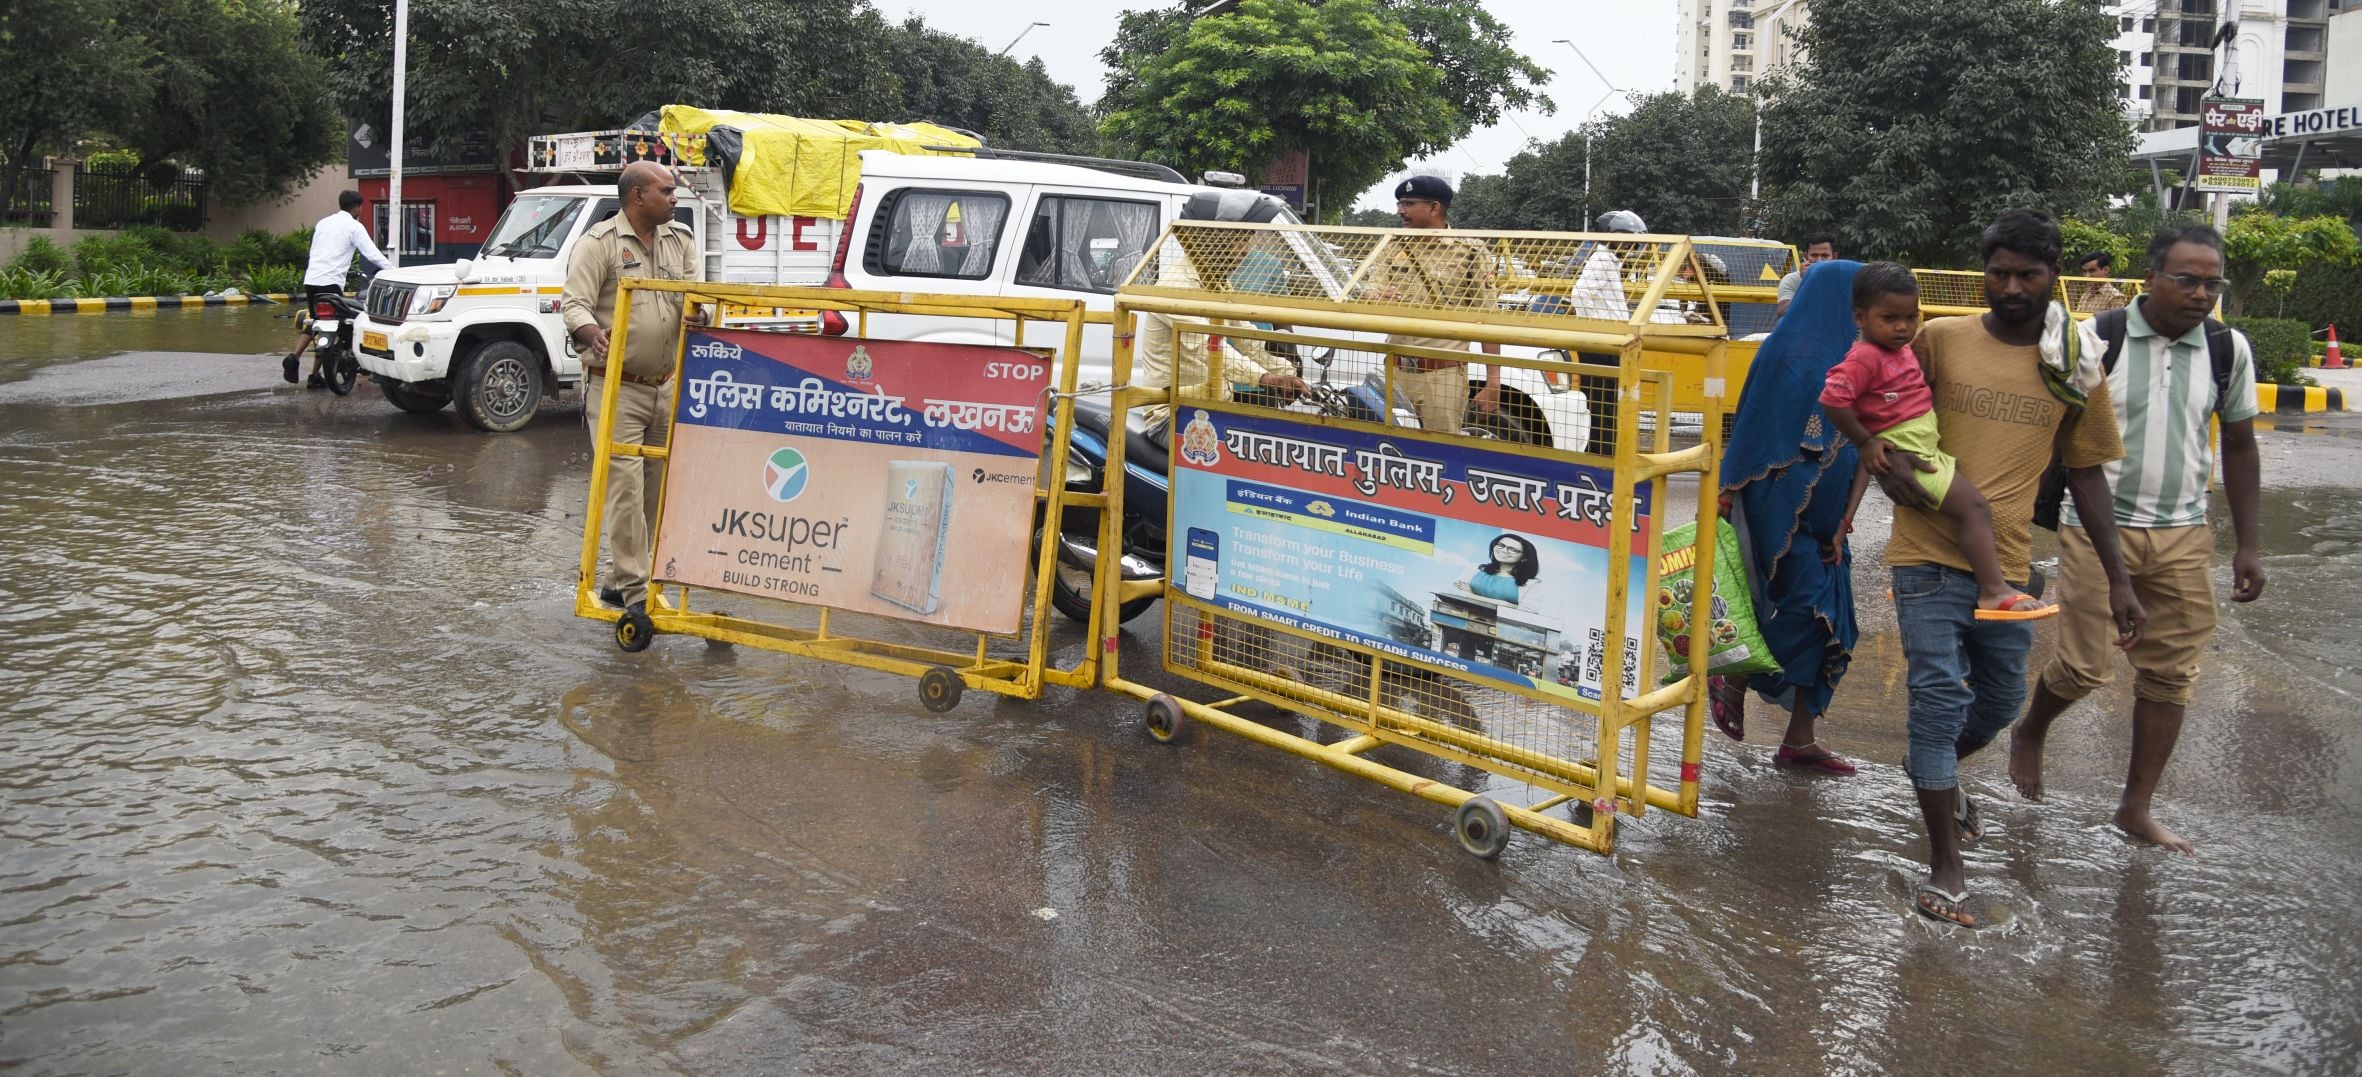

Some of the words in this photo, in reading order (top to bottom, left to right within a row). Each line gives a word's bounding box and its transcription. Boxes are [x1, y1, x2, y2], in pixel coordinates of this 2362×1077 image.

[2205, 107, 2227, 127] पैर
[2236, 108, 2263, 132] एड़ी
[2294, 107, 2362, 133] HOTEL
[692, 342, 743, 360] रूकिये
[987, 362, 1044, 381] STOP
[689, 370, 764, 418] पुलिस
[770, 377, 912, 426] कमिश्नरेट,
[923, 398, 1036, 434] लखनऊ
[1943, 382, 2055, 427] HIGHER
[784, 421, 823, 435] यातायात
[827, 422, 856, 437] नियमो
[859, 428, 872, 439] का
[875, 430, 902, 442] पालन
[905, 430, 923, 443] करें
[1226, 428, 1348, 477] यातायात
[1352, 441, 1455, 505] पुलिस,
[1466, 468, 1548, 515] उत्तर
[1237, 488, 1274, 502] इंडियन
[1275, 495, 1294, 506] बैंक
[1256, 509, 1292, 521] इलाहाबाद
[1345, 509, 1386, 525] Indian
[1389, 519, 1423, 533] Bank
[1345, 528, 1387, 541] ALLAHABAD
[737, 549, 813, 574] cement
[1231, 541, 1299, 566] Transform
[1301, 557, 1333, 575] your
[1338, 565, 1364, 581] Life
[1232, 526, 1300, 552] Transform
[1303, 543, 1335, 560] your
[1338, 550, 1406, 576] Business
[723, 570, 761, 588] BUILD
[764, 576, 820, 597] STRONG
[1230, 558, 1246, 569] Get
[1301, 575, 1310, 584] in
[1310, 577, 1331, 591] just
[1231, 583, 1258, 597] IND
[1228, 602, 1258, 617] FROM
[1261, 611, 1299, 628] SMART
[1302, 622, 1342, 639] CREDIT
[1345, 633, 1359, 644] TO
[1363, 639, 1408, 657] STEADY
[1411, 651, 1469, 672] SUCCESS
